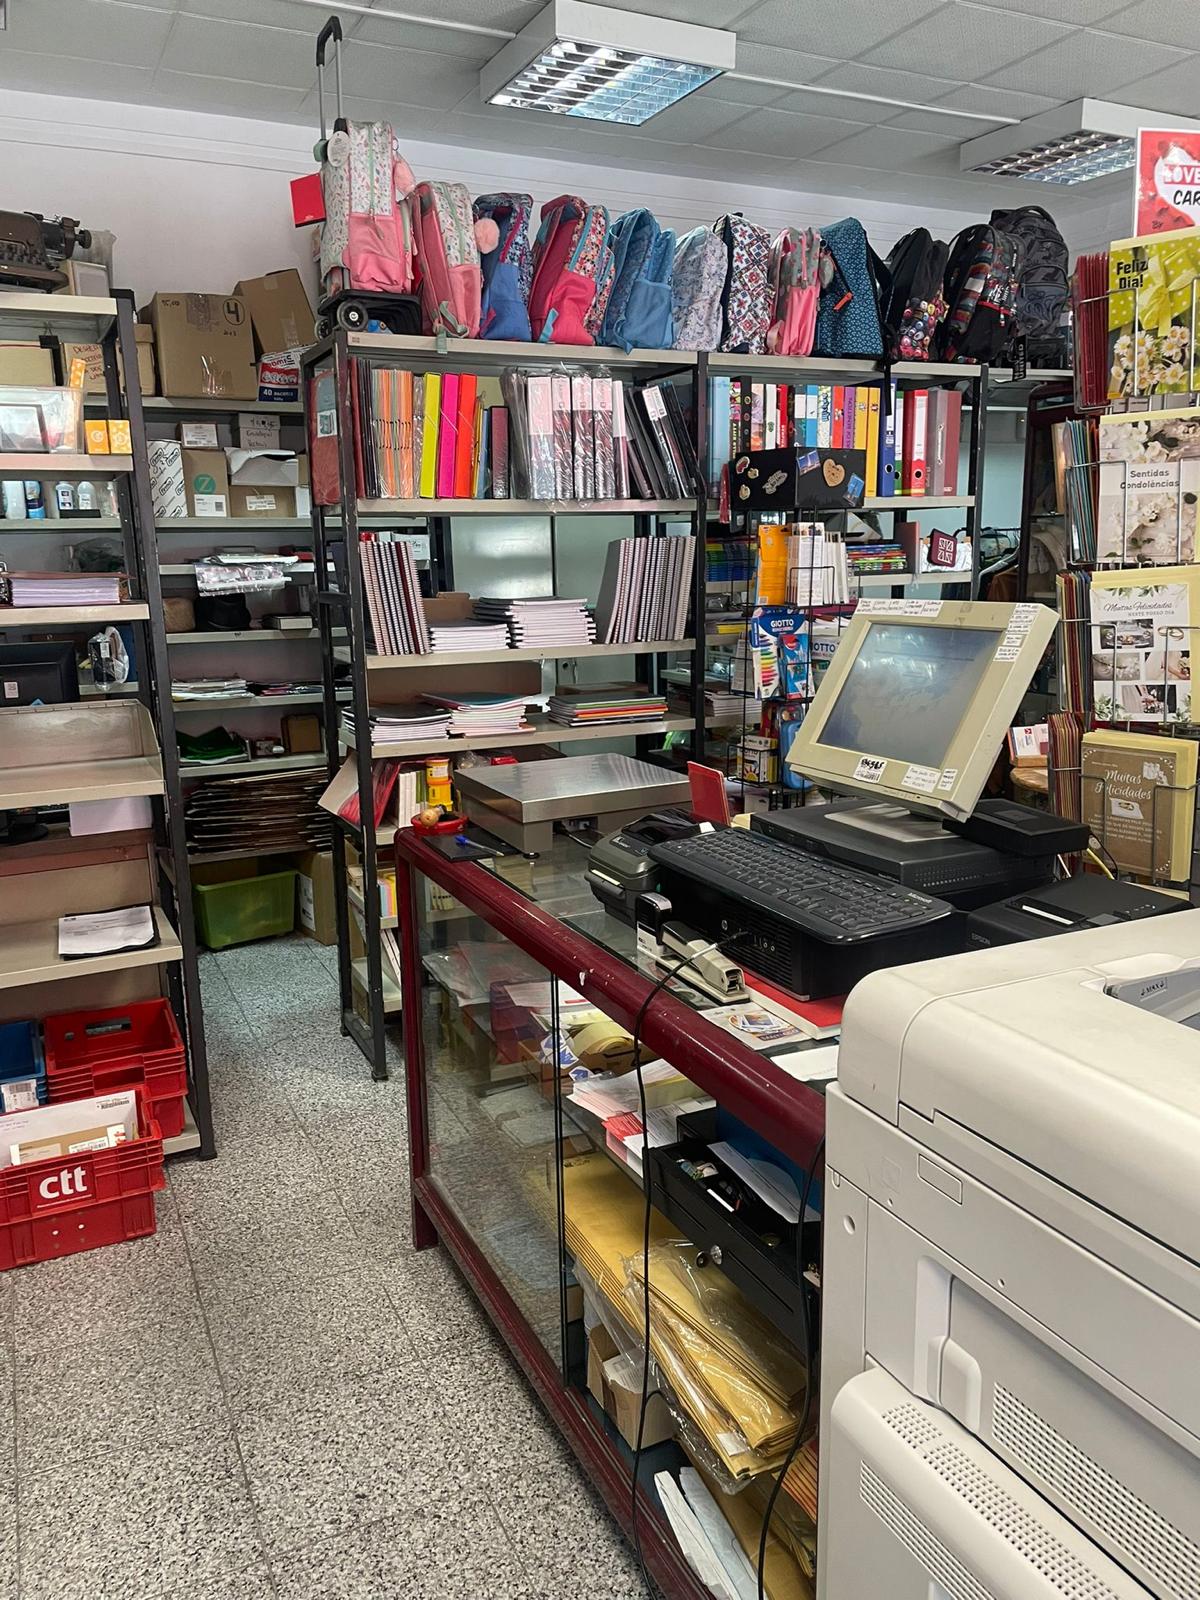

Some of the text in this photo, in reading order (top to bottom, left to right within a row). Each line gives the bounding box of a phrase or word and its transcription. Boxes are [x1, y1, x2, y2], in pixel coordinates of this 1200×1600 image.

[1116, 259, 1148, 276] Feliz
[1119, 274, 1144, 289] Dia!
[226, 301, 240, 323] 4
[263, 388, 273, 396] 40
[1129, 469, 1170, 478] Sentidas
[1120, 479, 1180, 490] Condolências
[770, 619, 794, 628] GIOTTO
[813, 642, 836, 653] OTTO
[1105, 769, 1142, 784] Muitas
[39, 1165, 88, 1200] ctt
